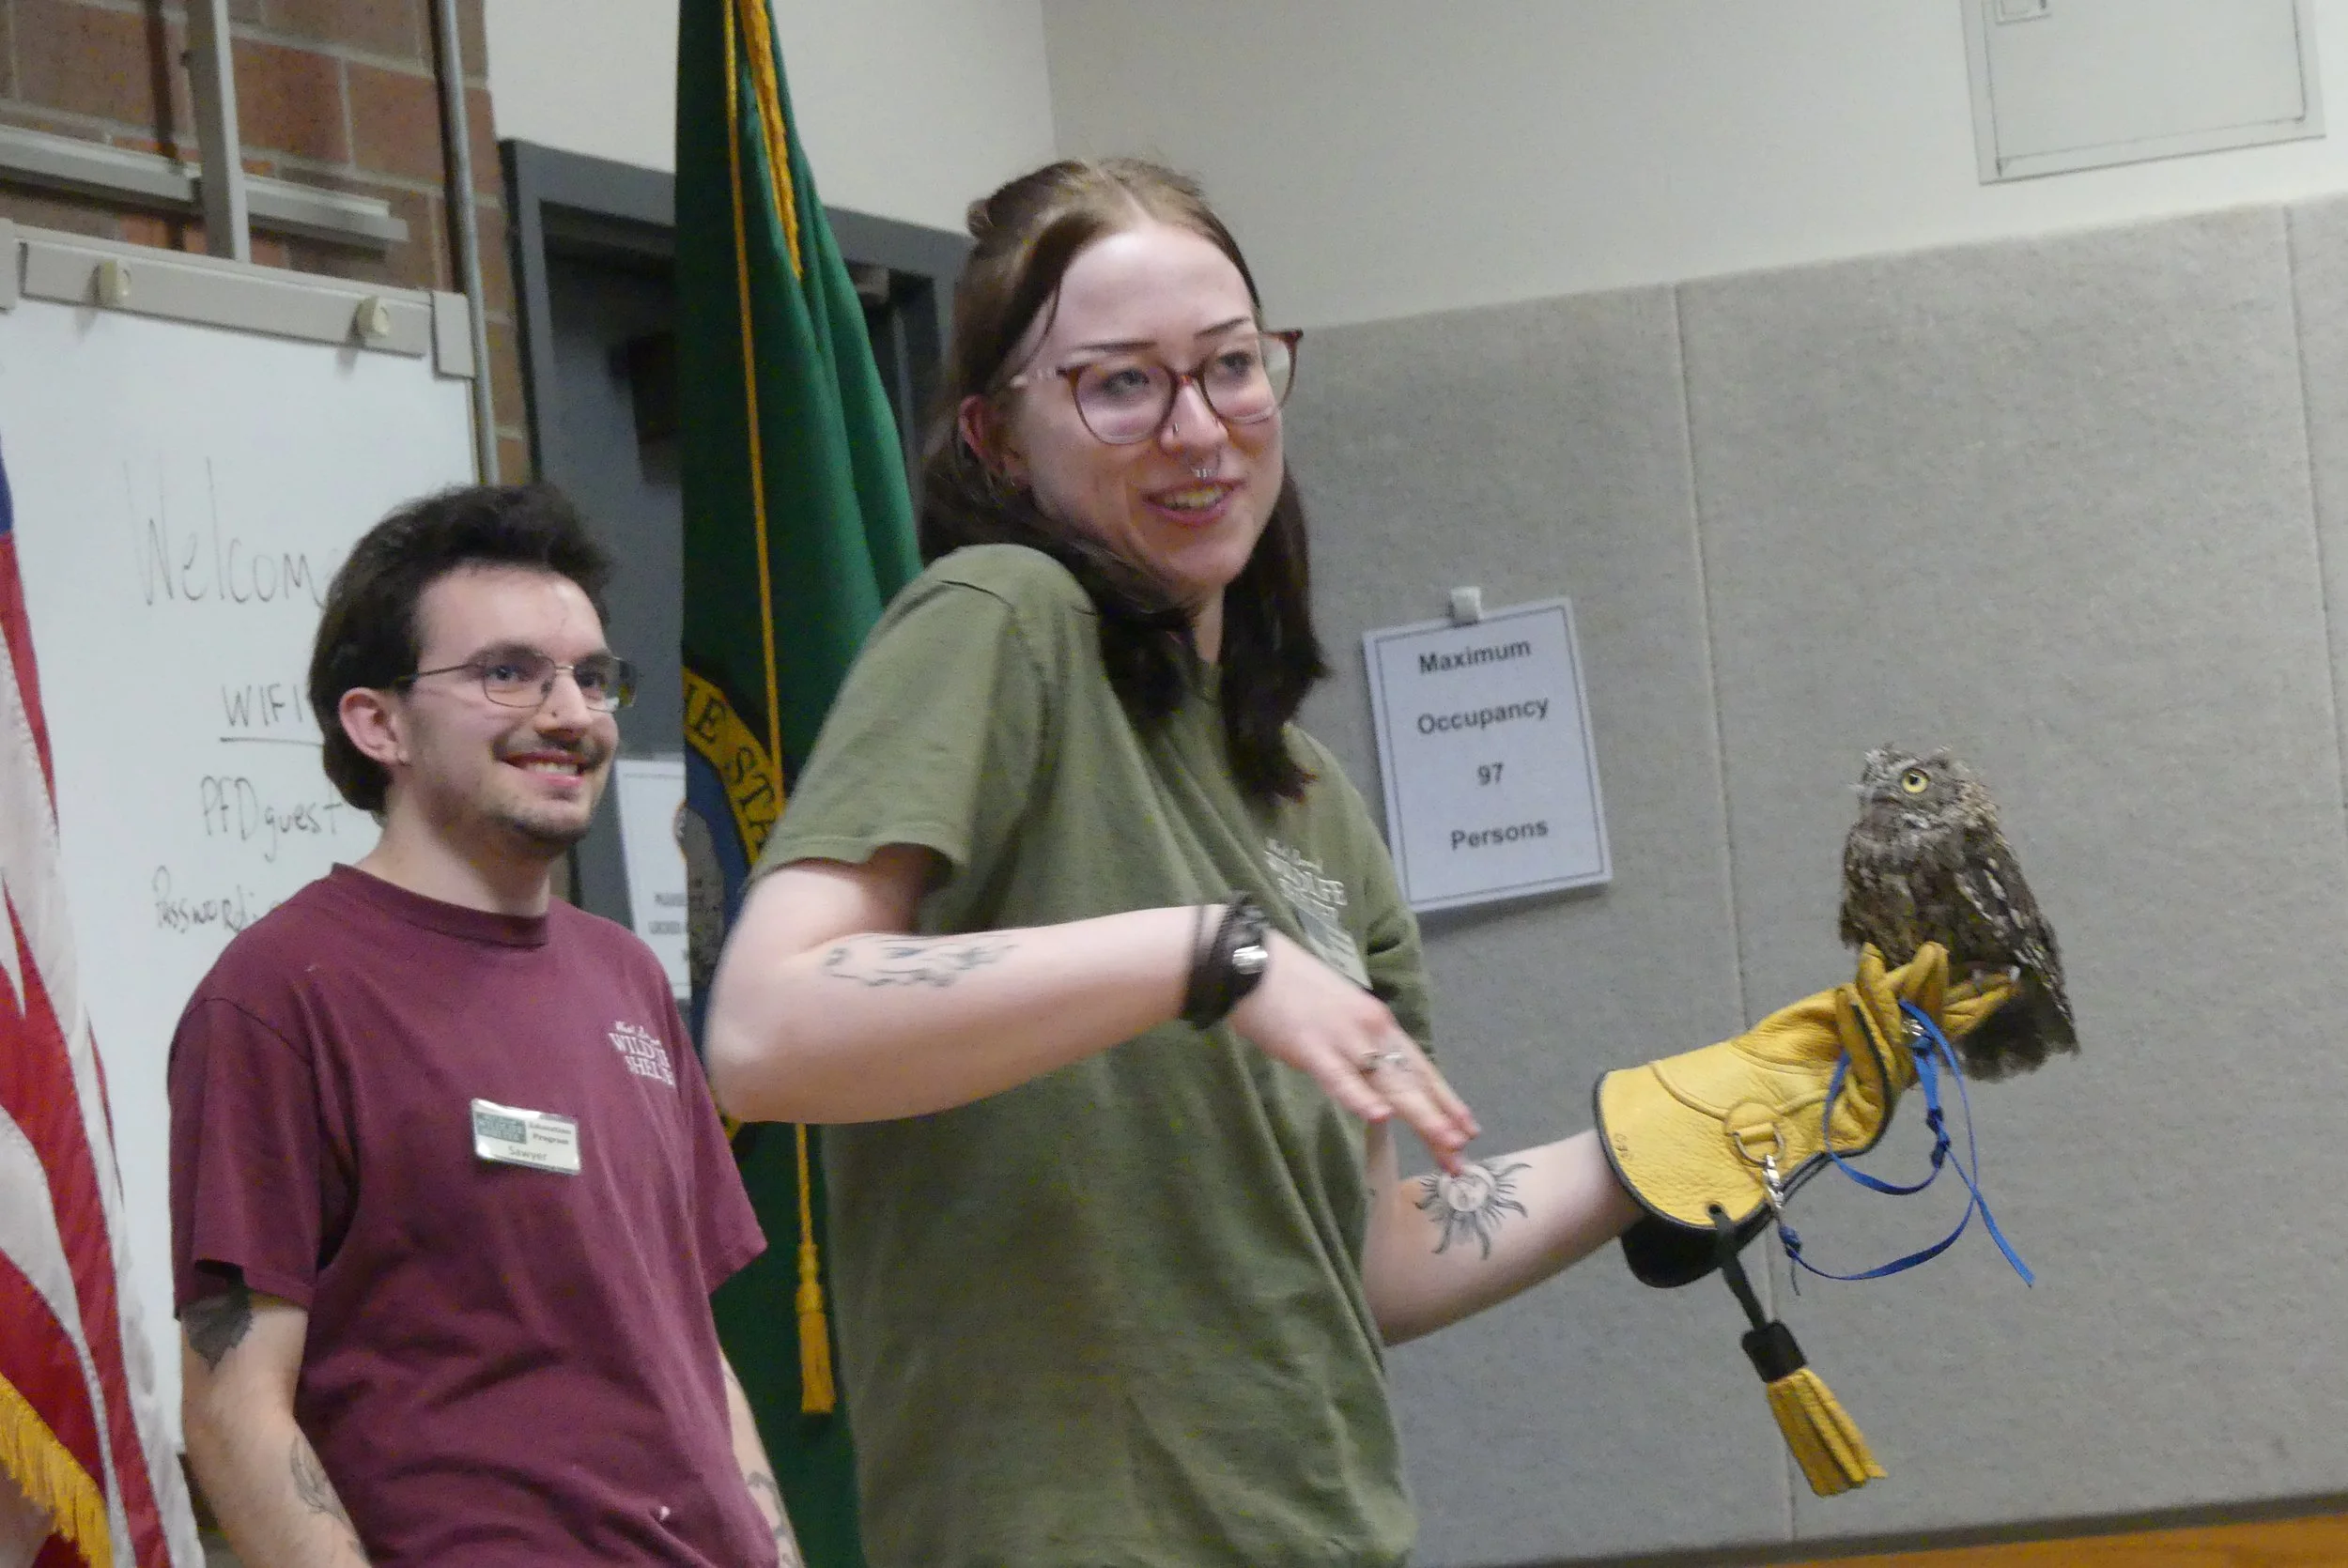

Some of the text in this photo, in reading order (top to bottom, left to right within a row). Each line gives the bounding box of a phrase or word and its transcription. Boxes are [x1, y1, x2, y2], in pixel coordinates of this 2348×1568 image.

[123, 456, 331, 608] Welcom
[1417, 639, 1532, 674] Maximum
[222, 683, 303, 729] WIFI
[1416, 698, 1550, 735] Occupancy
[1476, 762, 1504, 786] 97
[1450, 820, 1549, 851] Persons
[508, 1145, 548, 1161] Sawyer
